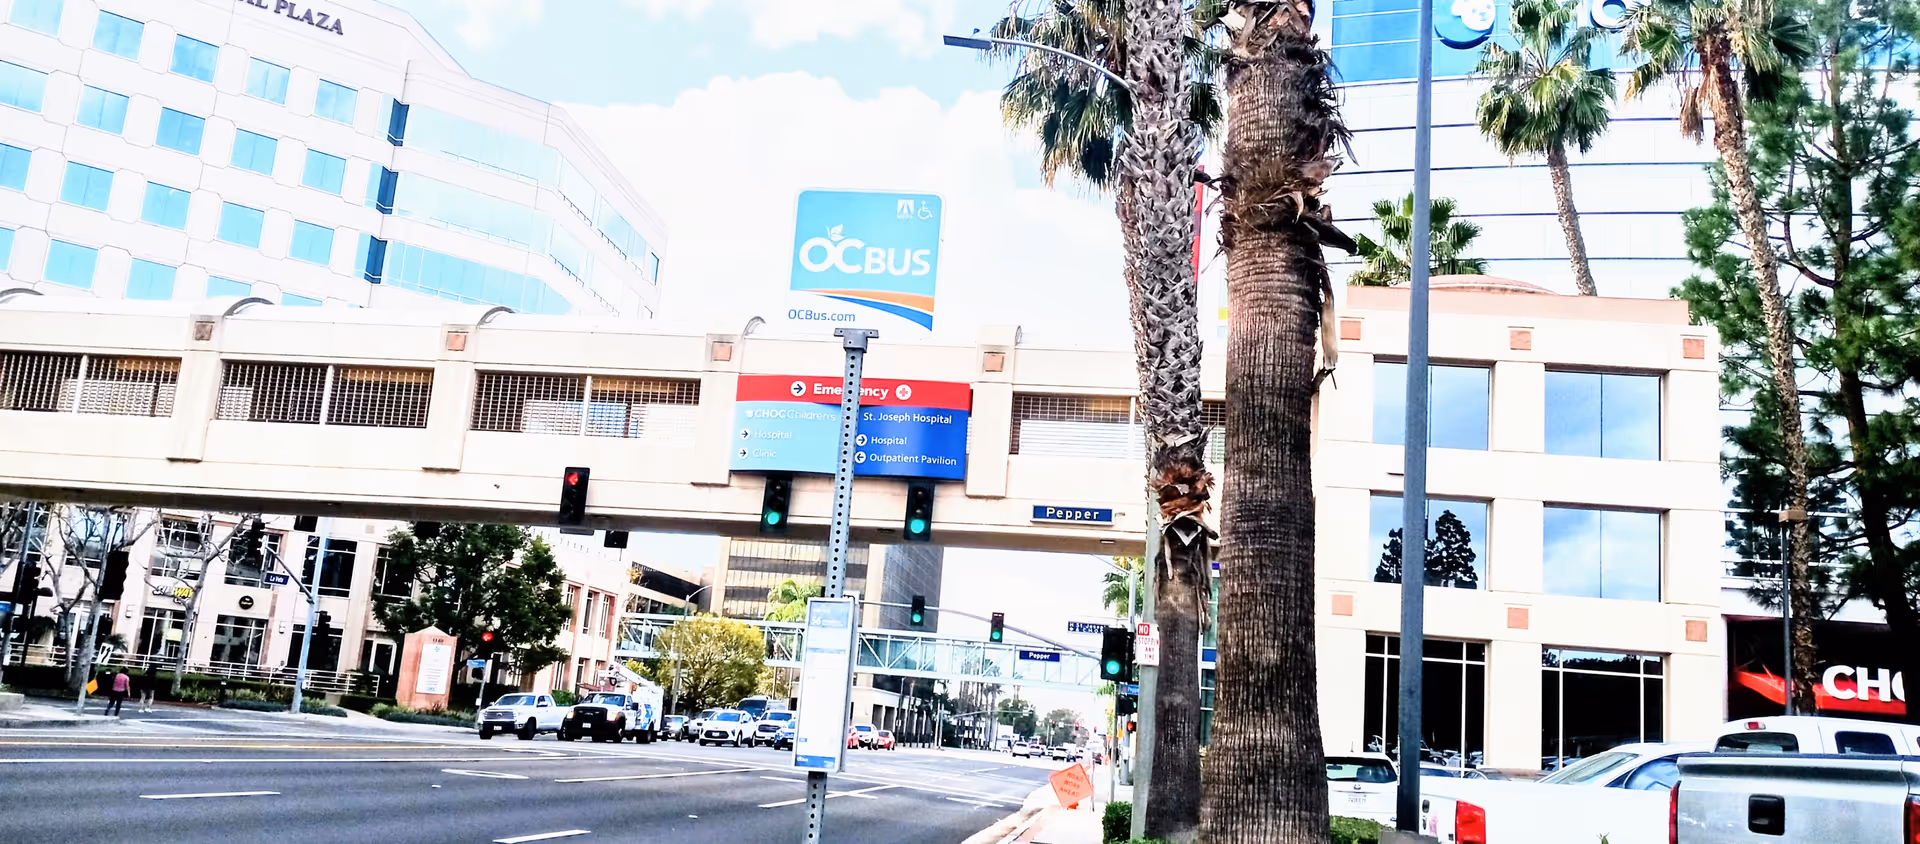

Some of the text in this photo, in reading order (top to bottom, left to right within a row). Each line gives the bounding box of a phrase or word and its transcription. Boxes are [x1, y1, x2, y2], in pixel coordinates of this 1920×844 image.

[274, 0, 343, 35] PLAZA
[788, 309, 856, 322] OCBus.com
[813, 383, 889, 400] Emeency
[863, 412, 952, 425] St. Joseph Hospital
[754, 430, 792, 440] Hospital
[871, 436, 907, 446] Hospital
[752, 448, 777, 458] Clinic
[869, 453, 957, 466] Outpatient Pavilion
[1046, 507, 1099, 520] Pepper
[1139, 625, 1149, 635] NO
[1029, 652, 1050, 660] Pepper
